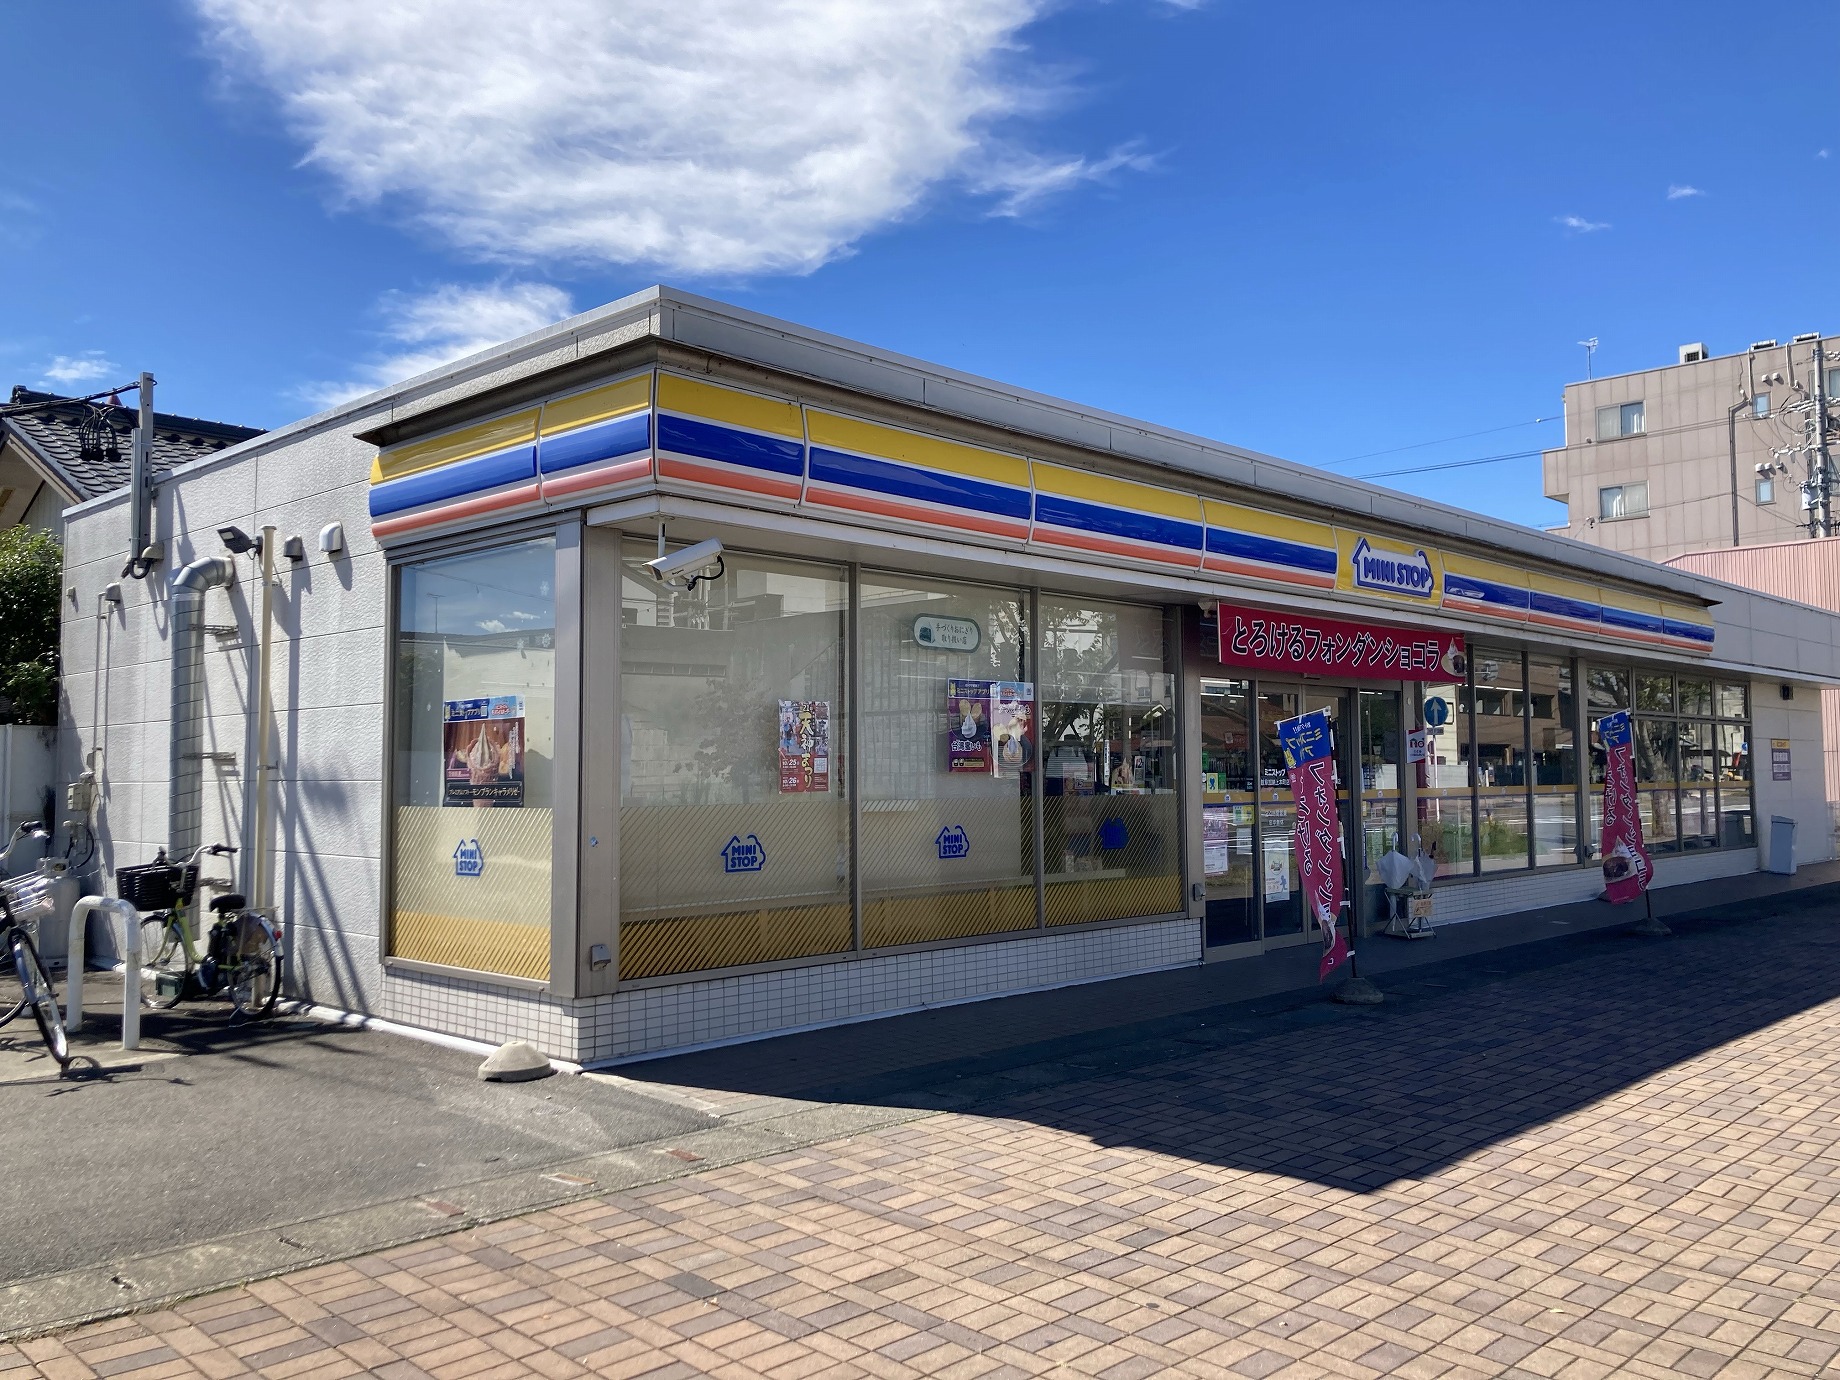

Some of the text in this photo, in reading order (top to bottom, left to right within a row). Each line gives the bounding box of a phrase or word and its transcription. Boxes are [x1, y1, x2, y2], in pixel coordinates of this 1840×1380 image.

[1364, 557, 1431, 588] MINI STOP
[936, 623, 973, 635] 手づくりおにぎり
[1231, 616, 1441, 671] とろけるフォンダンショコラ
[799, 711, 814, 788] 天神まつり
[1264, 768, 1286, 777] ミニストップ
[943, 834, 962, 845] MINI
[460, 848, 477, 860] MINI
[731, 844, 757, 856] MINI
[942, 844, 964, 855] STOP
[459, 860, 478, 872] STOP
[730, 856, 758, 868] STOP
